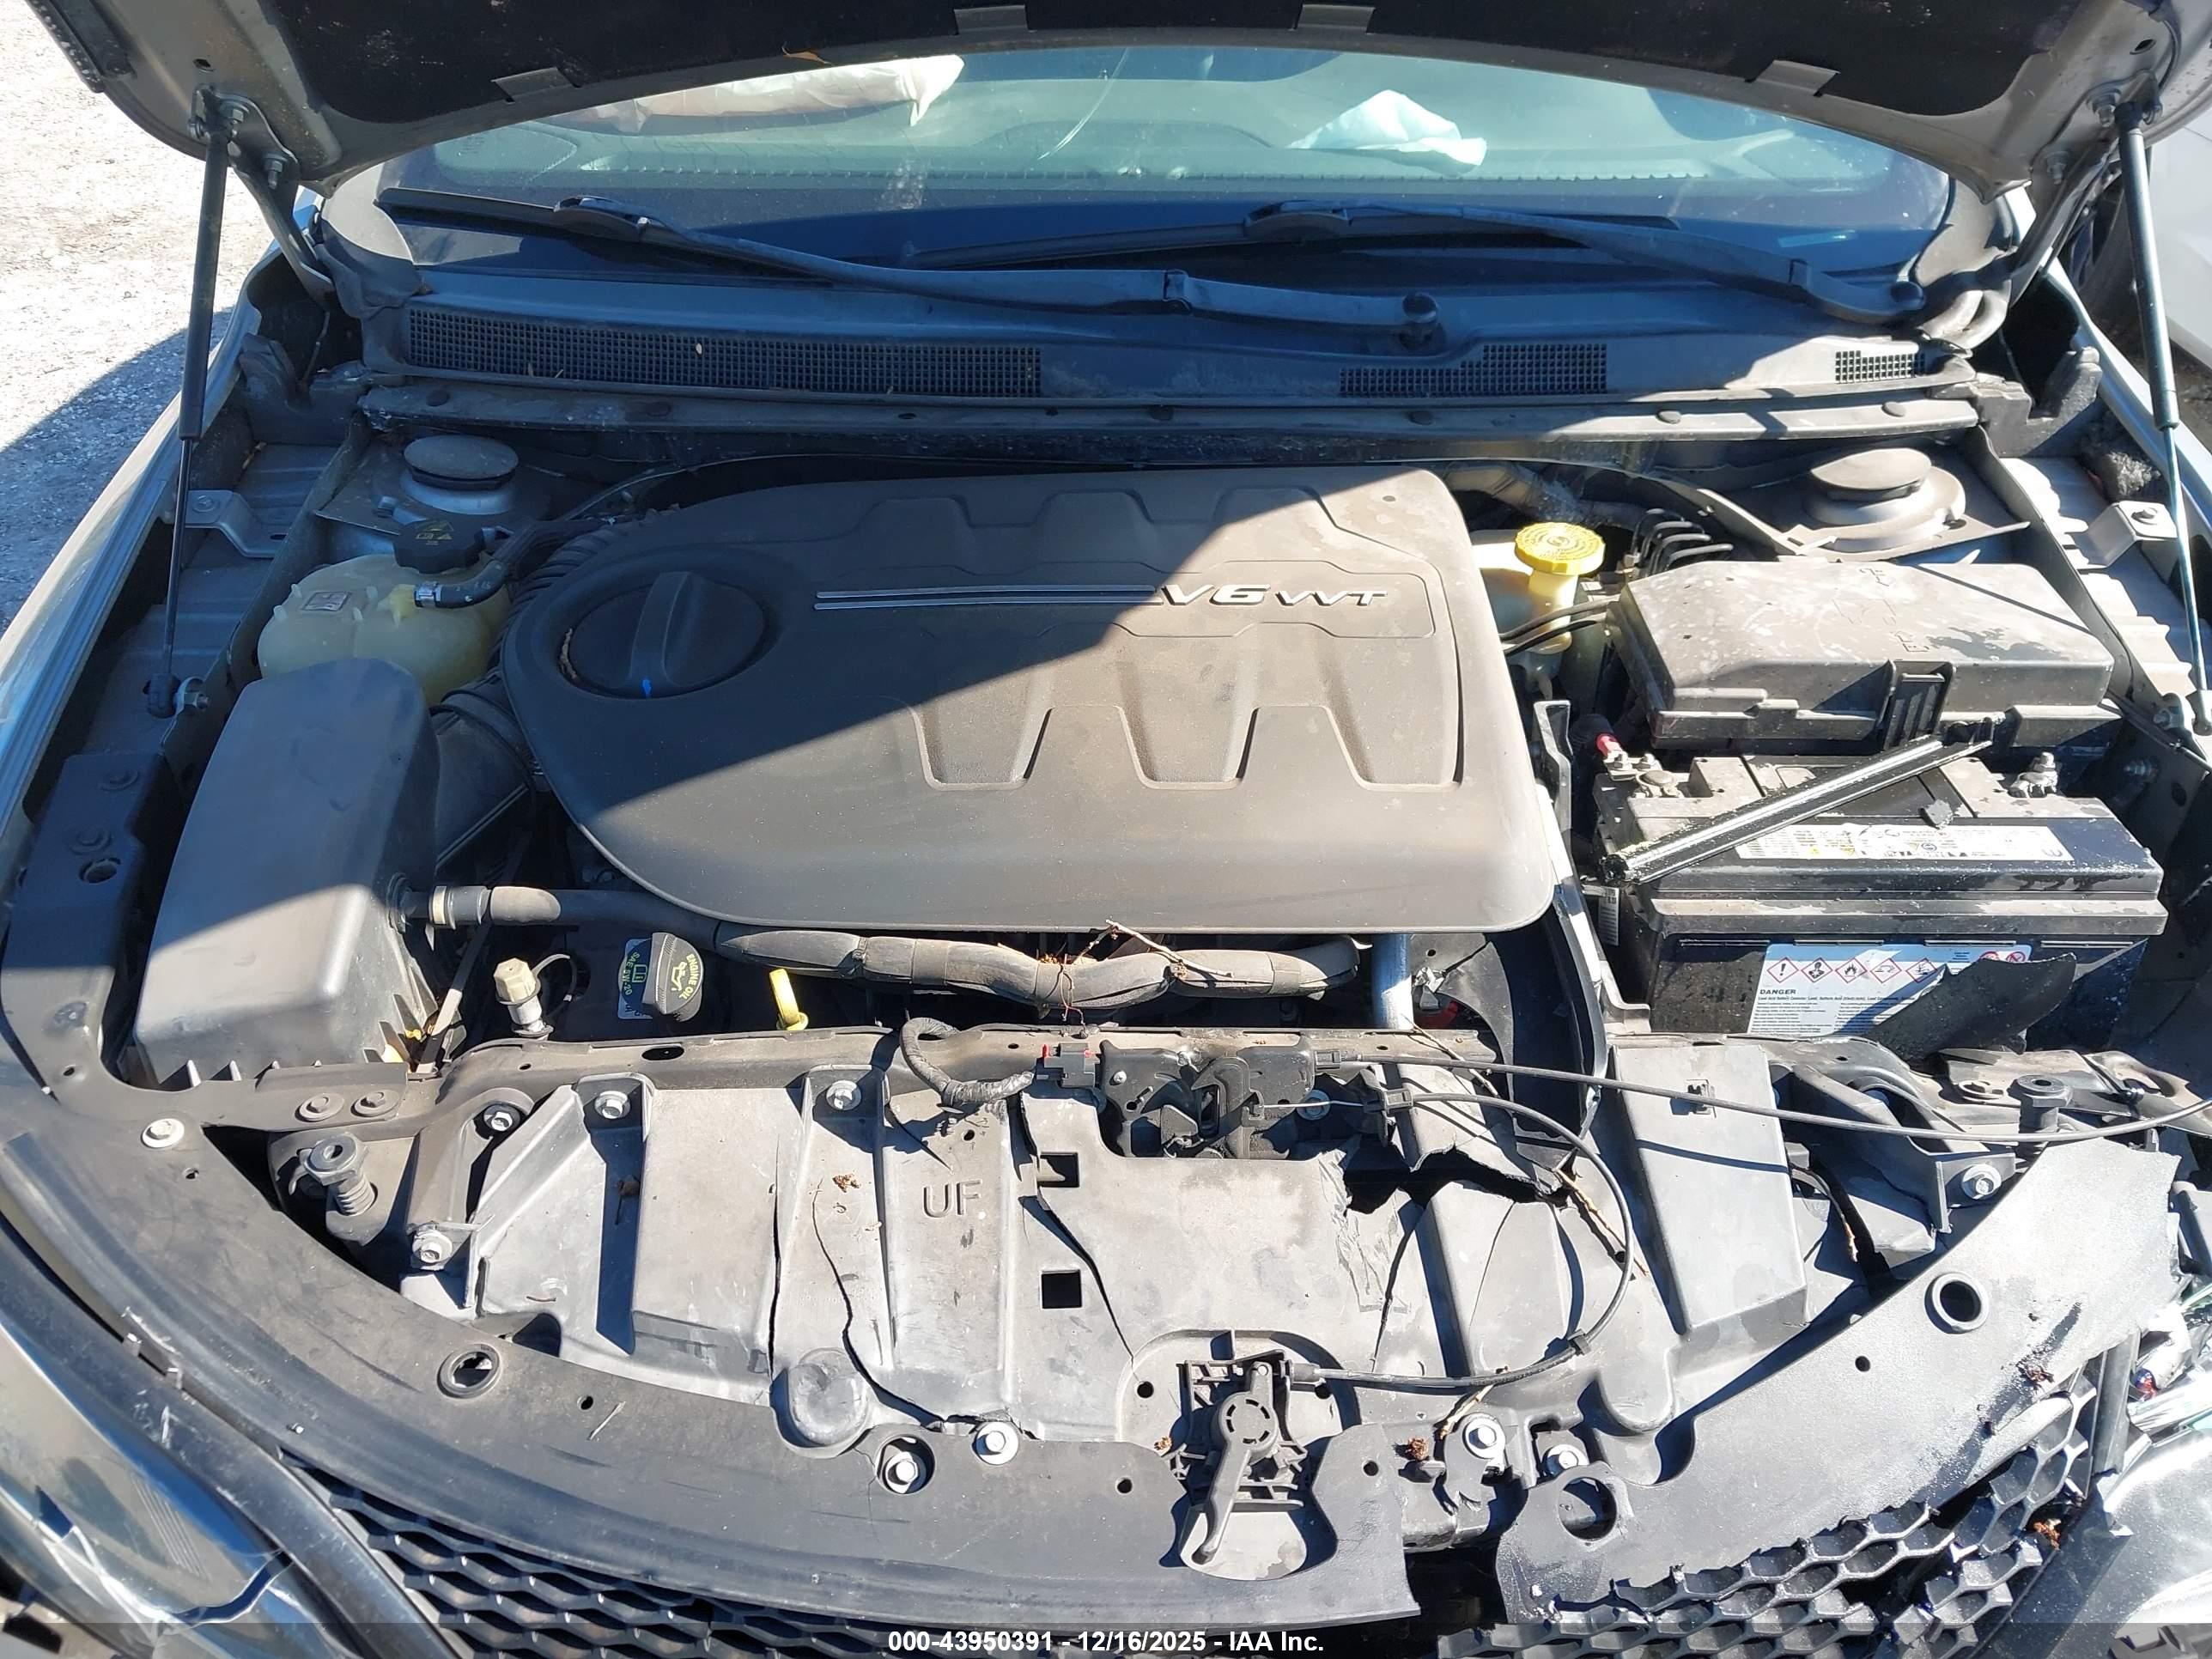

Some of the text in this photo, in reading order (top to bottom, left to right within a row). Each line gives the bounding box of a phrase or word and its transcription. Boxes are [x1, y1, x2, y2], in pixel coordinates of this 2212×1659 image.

[1162, 583, 1389, 606] V6 VVT
[626, 951, 640, 969] SAE
[679, 953, 699, 1000] ENGINE OIL
[923, 1180, 981, 1217] UF
